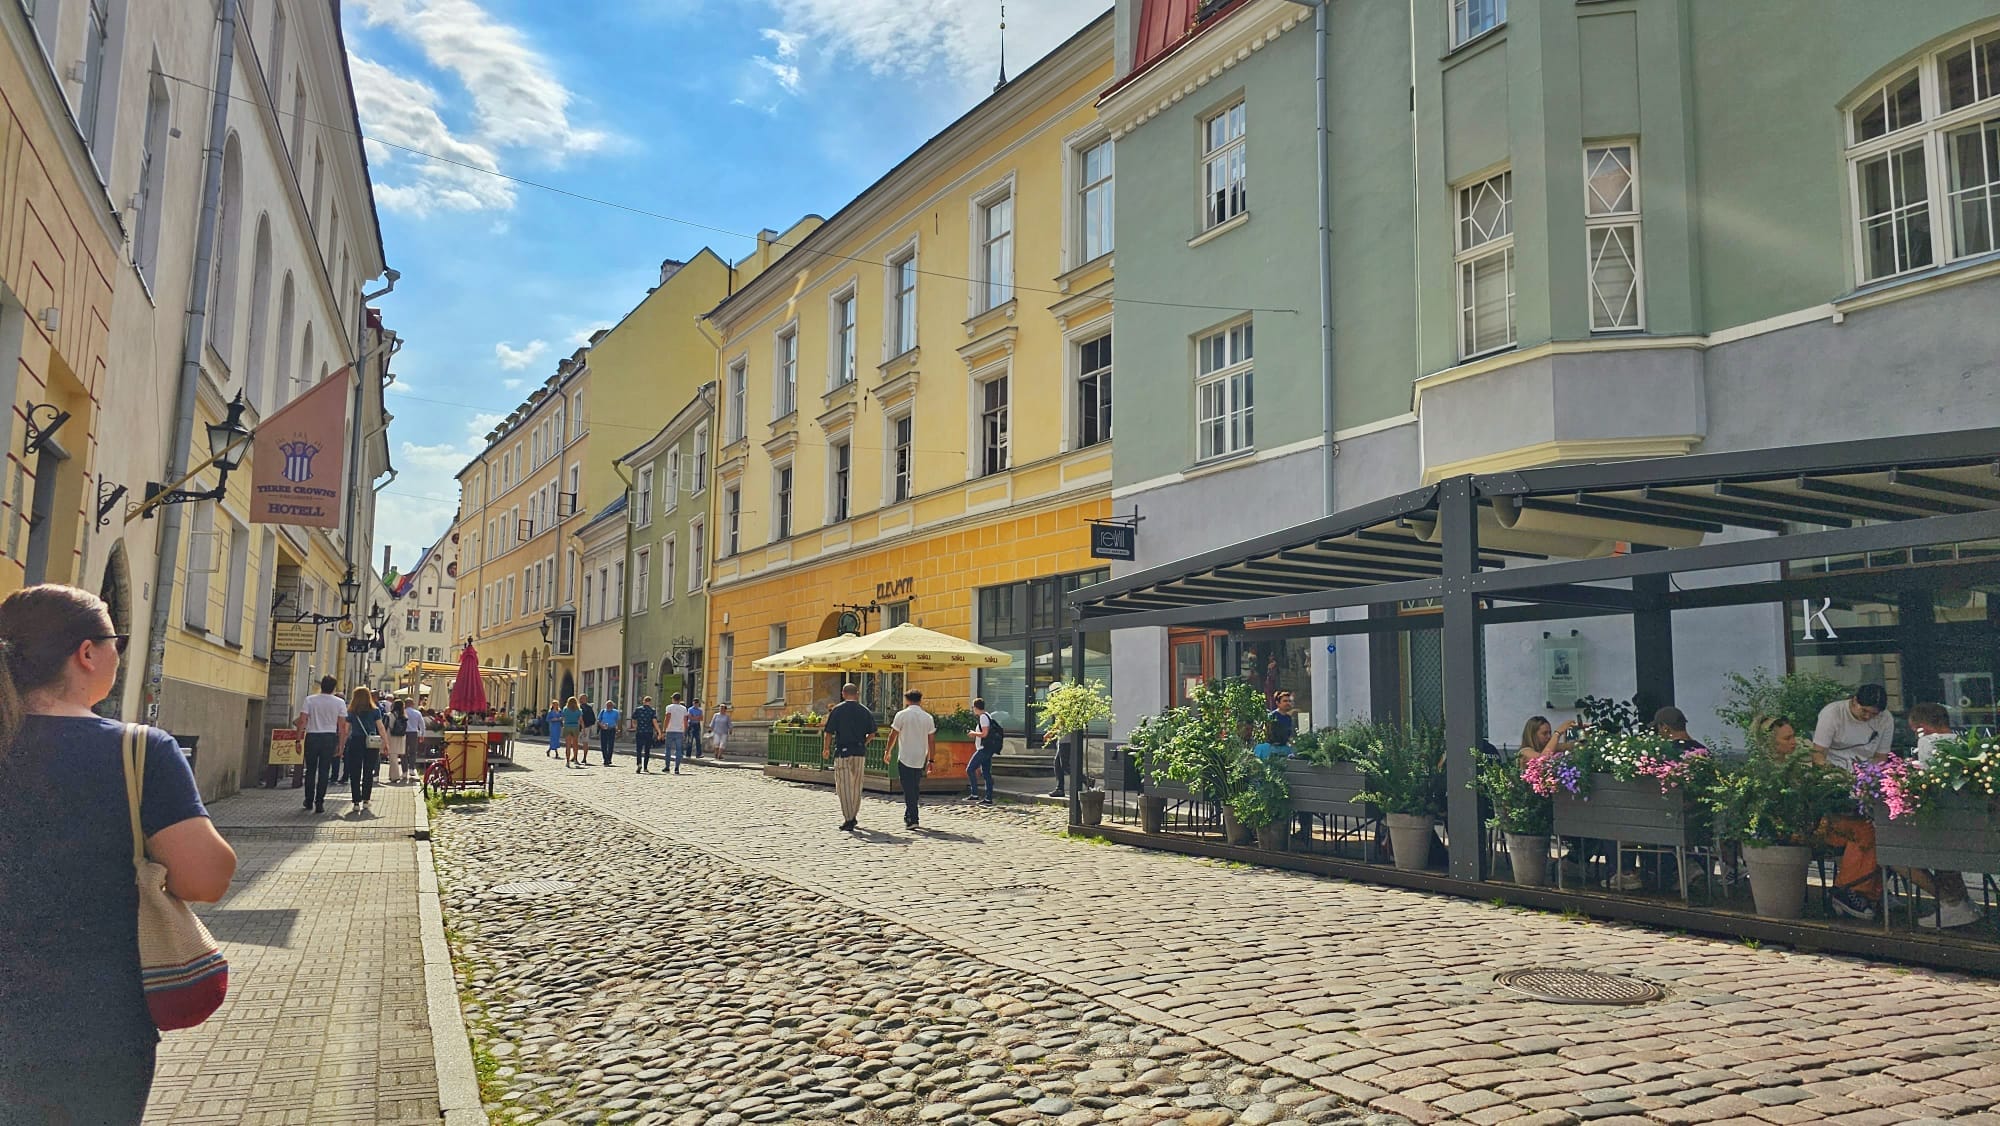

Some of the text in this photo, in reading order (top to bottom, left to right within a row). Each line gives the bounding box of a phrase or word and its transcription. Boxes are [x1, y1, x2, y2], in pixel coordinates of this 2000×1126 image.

[257, 485, 291, 493] THREE
[293, 486, 336, 498] CROWNS
[268, 503, 325, 517] HOTELL
[1802, 597, 1838, 640] K
